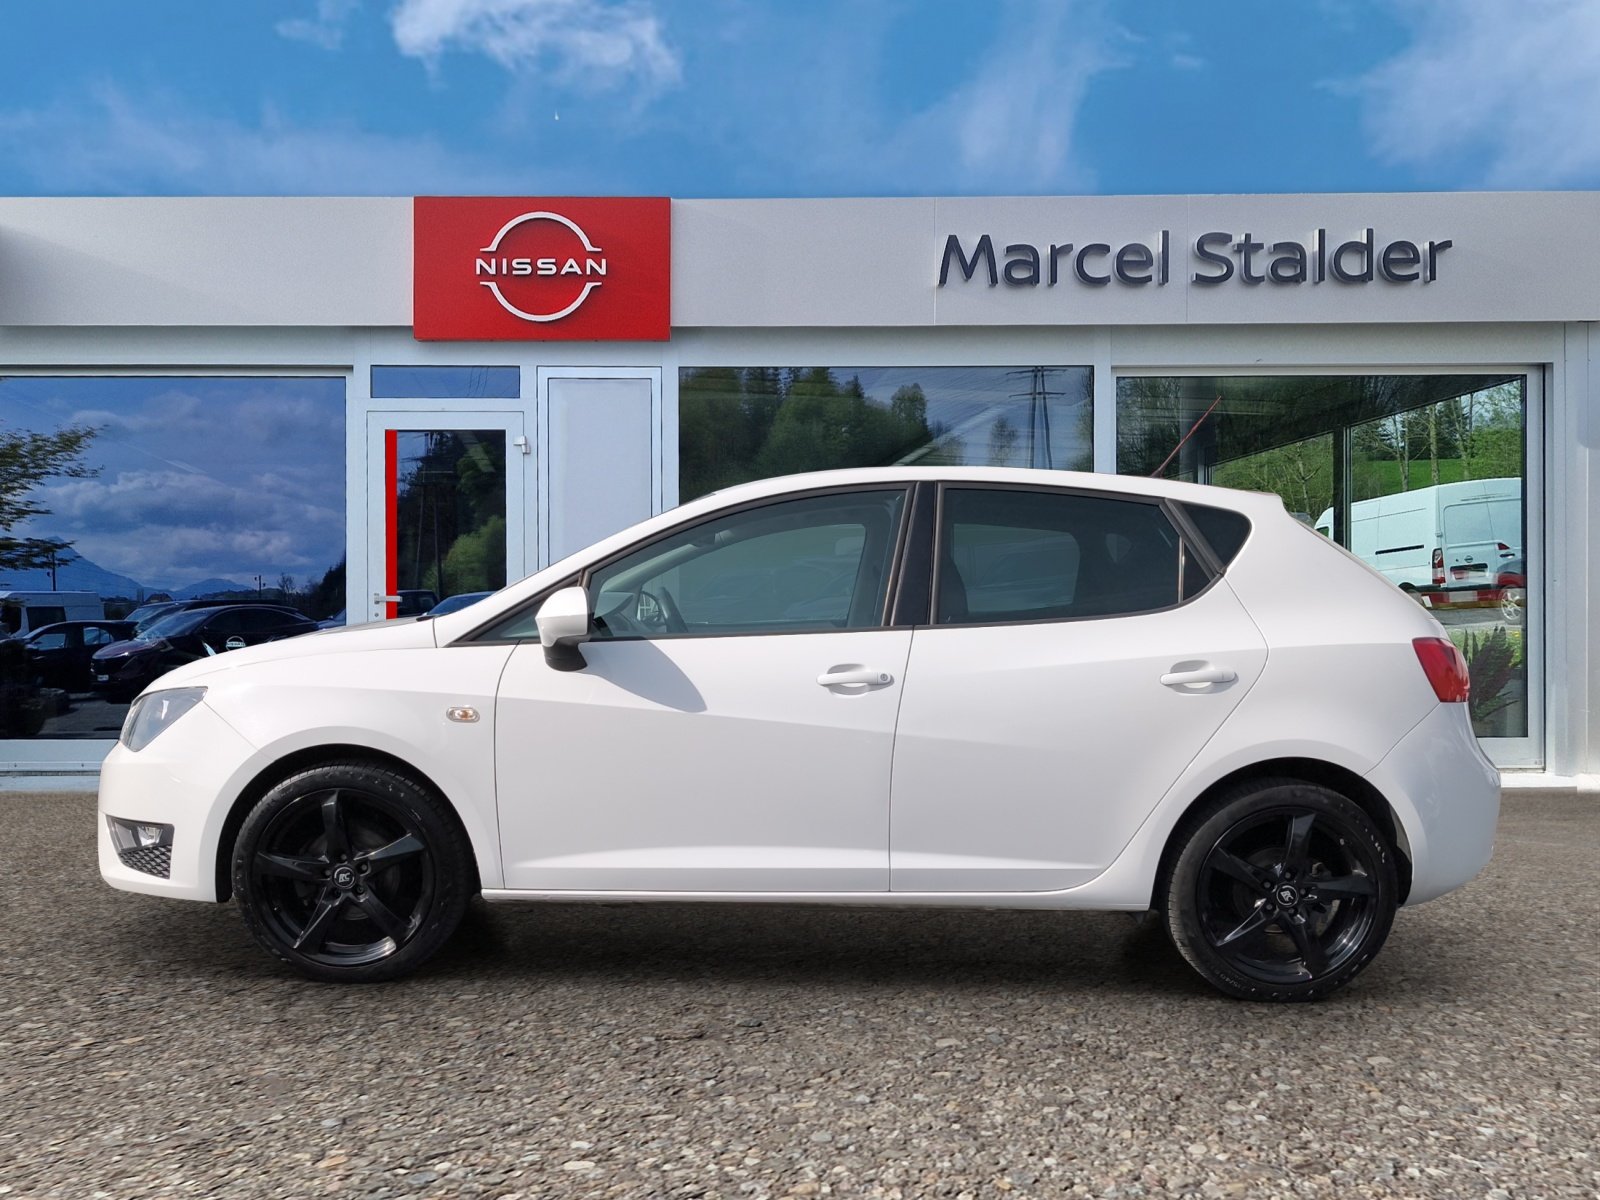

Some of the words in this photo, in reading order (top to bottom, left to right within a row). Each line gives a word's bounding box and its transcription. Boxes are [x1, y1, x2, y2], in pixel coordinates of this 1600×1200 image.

[475, 258, 607, 275] NISSAN
[938, 230, 1170, 287] Marcel
[1191, 228, 1453, 286] Stalder
